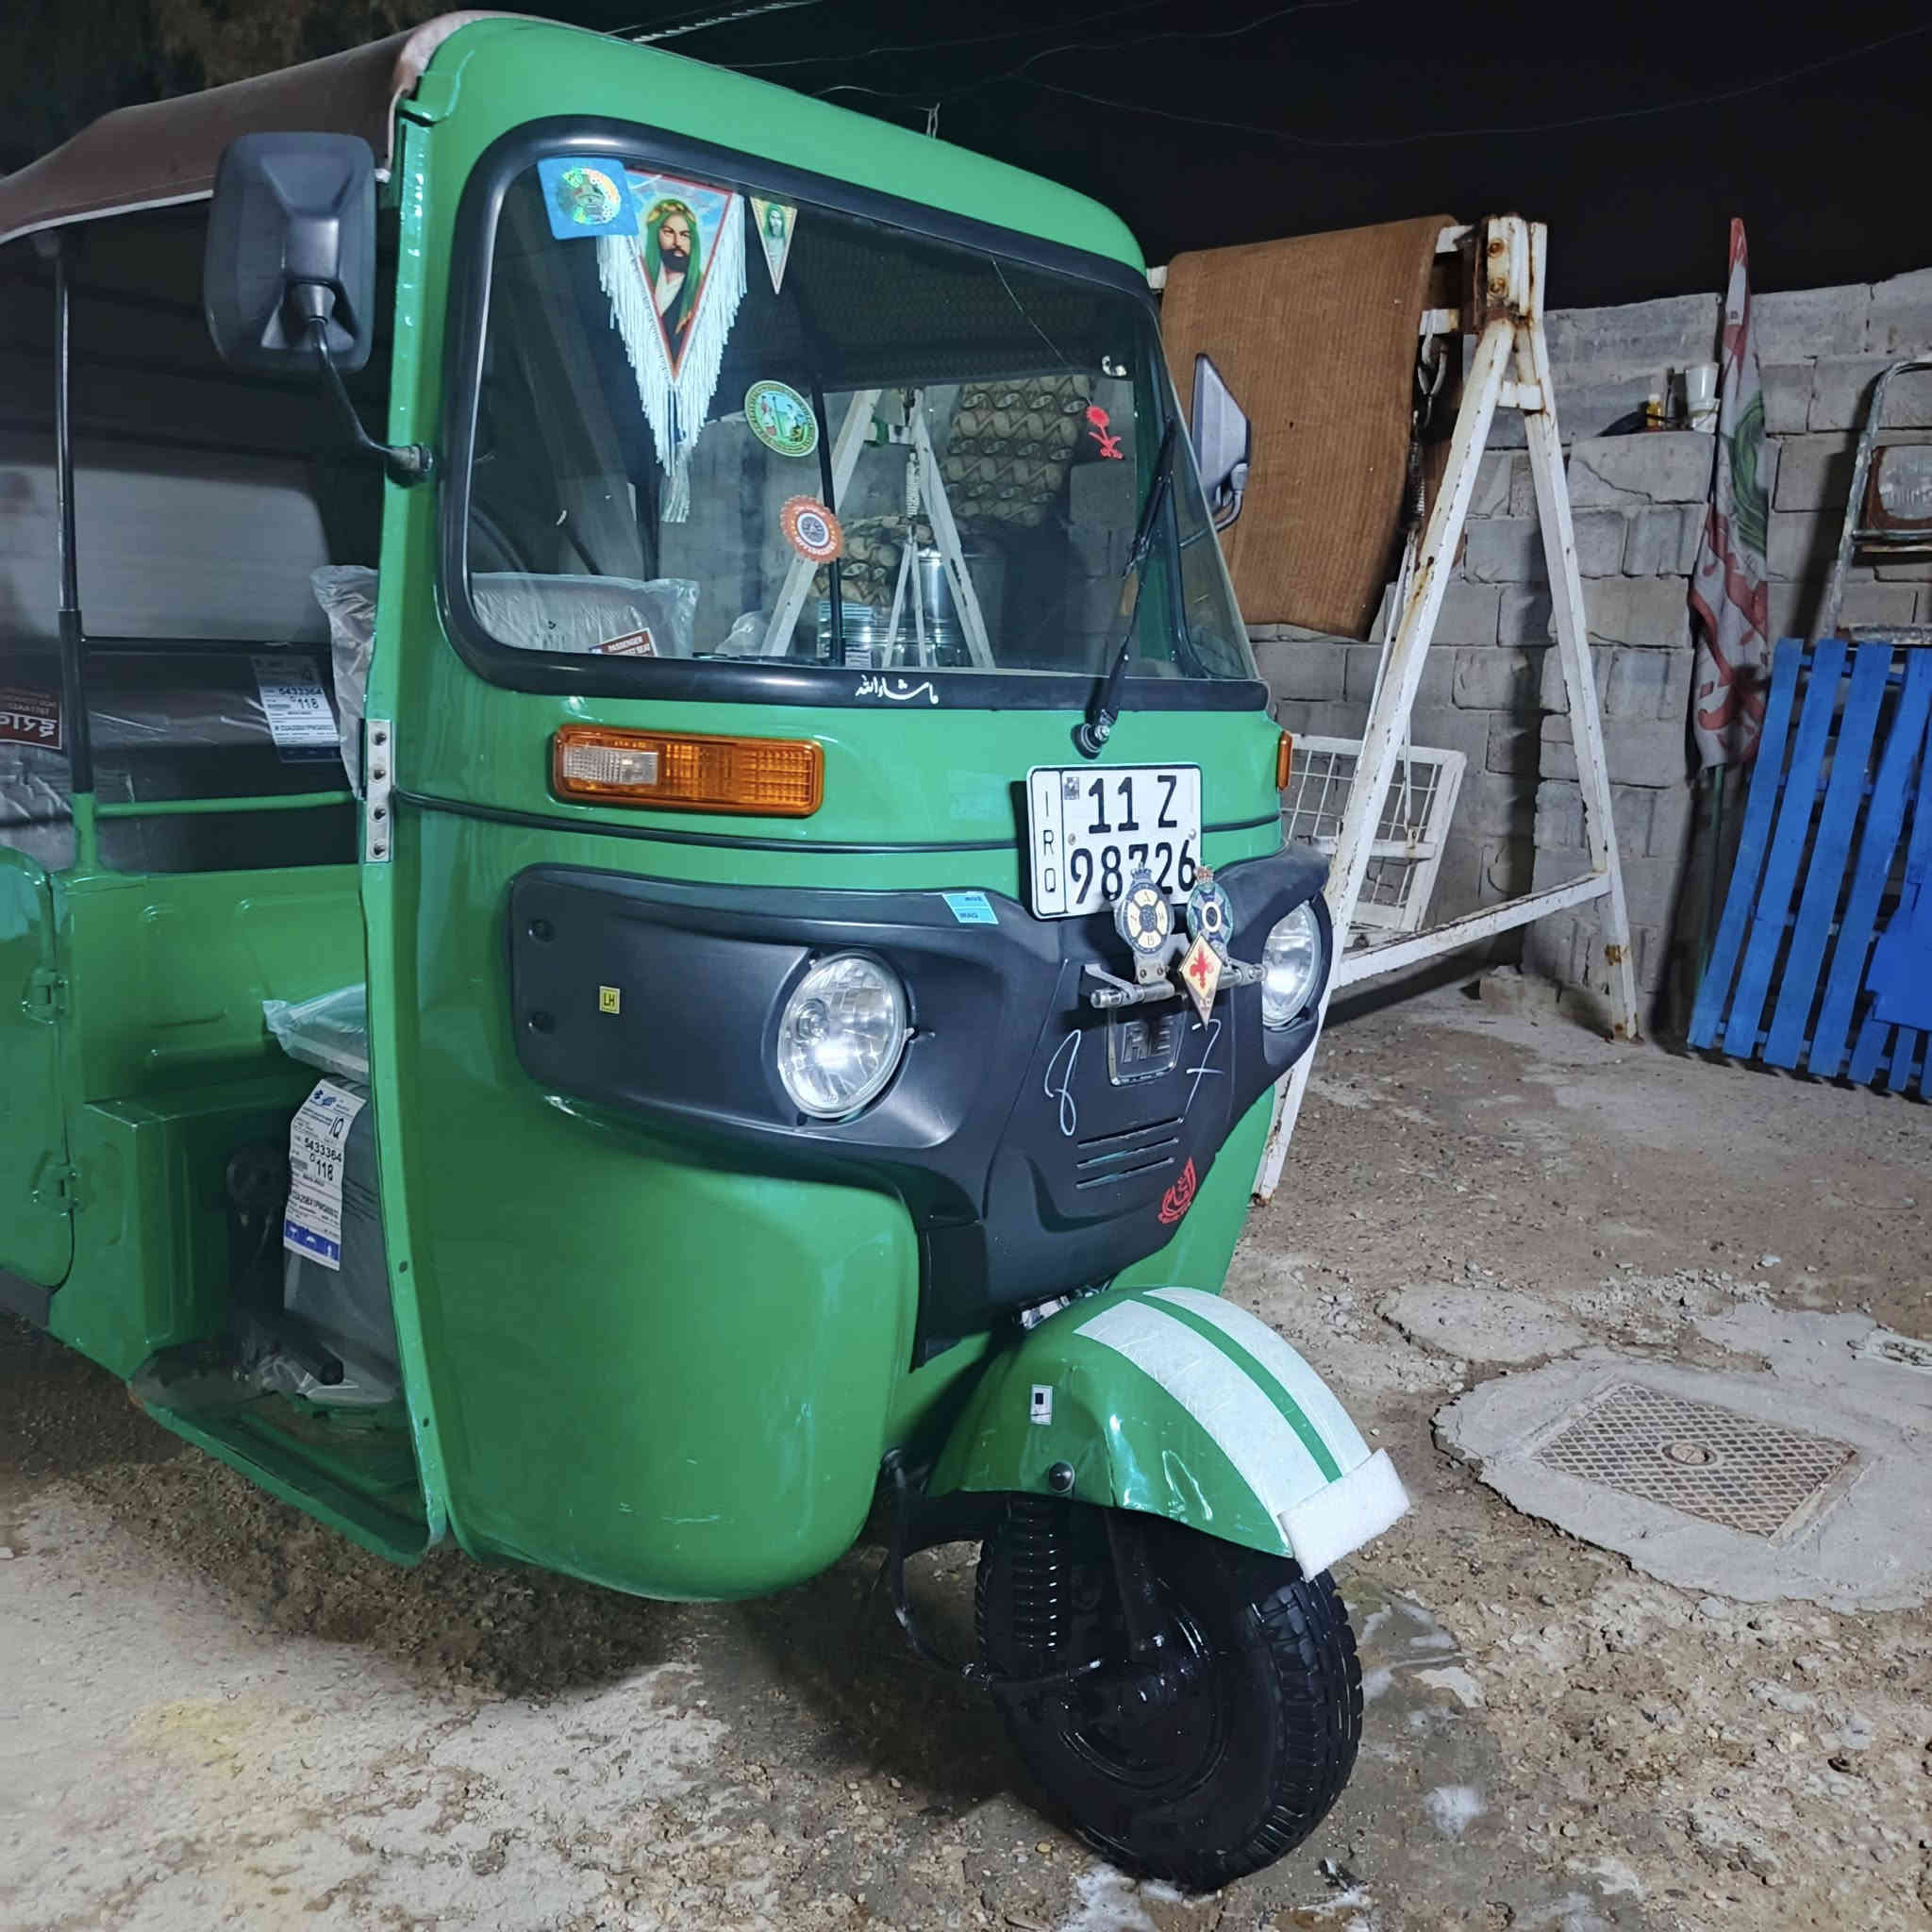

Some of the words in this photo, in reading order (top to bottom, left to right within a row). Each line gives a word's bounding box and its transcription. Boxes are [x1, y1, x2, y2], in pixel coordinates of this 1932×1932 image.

[1088, 776, 1140, 834] 11
[1157, 774, 1178, 828] Z
[1070, 839, 1197, 905] 98726
[316, 1159, 334, 1181] 118
